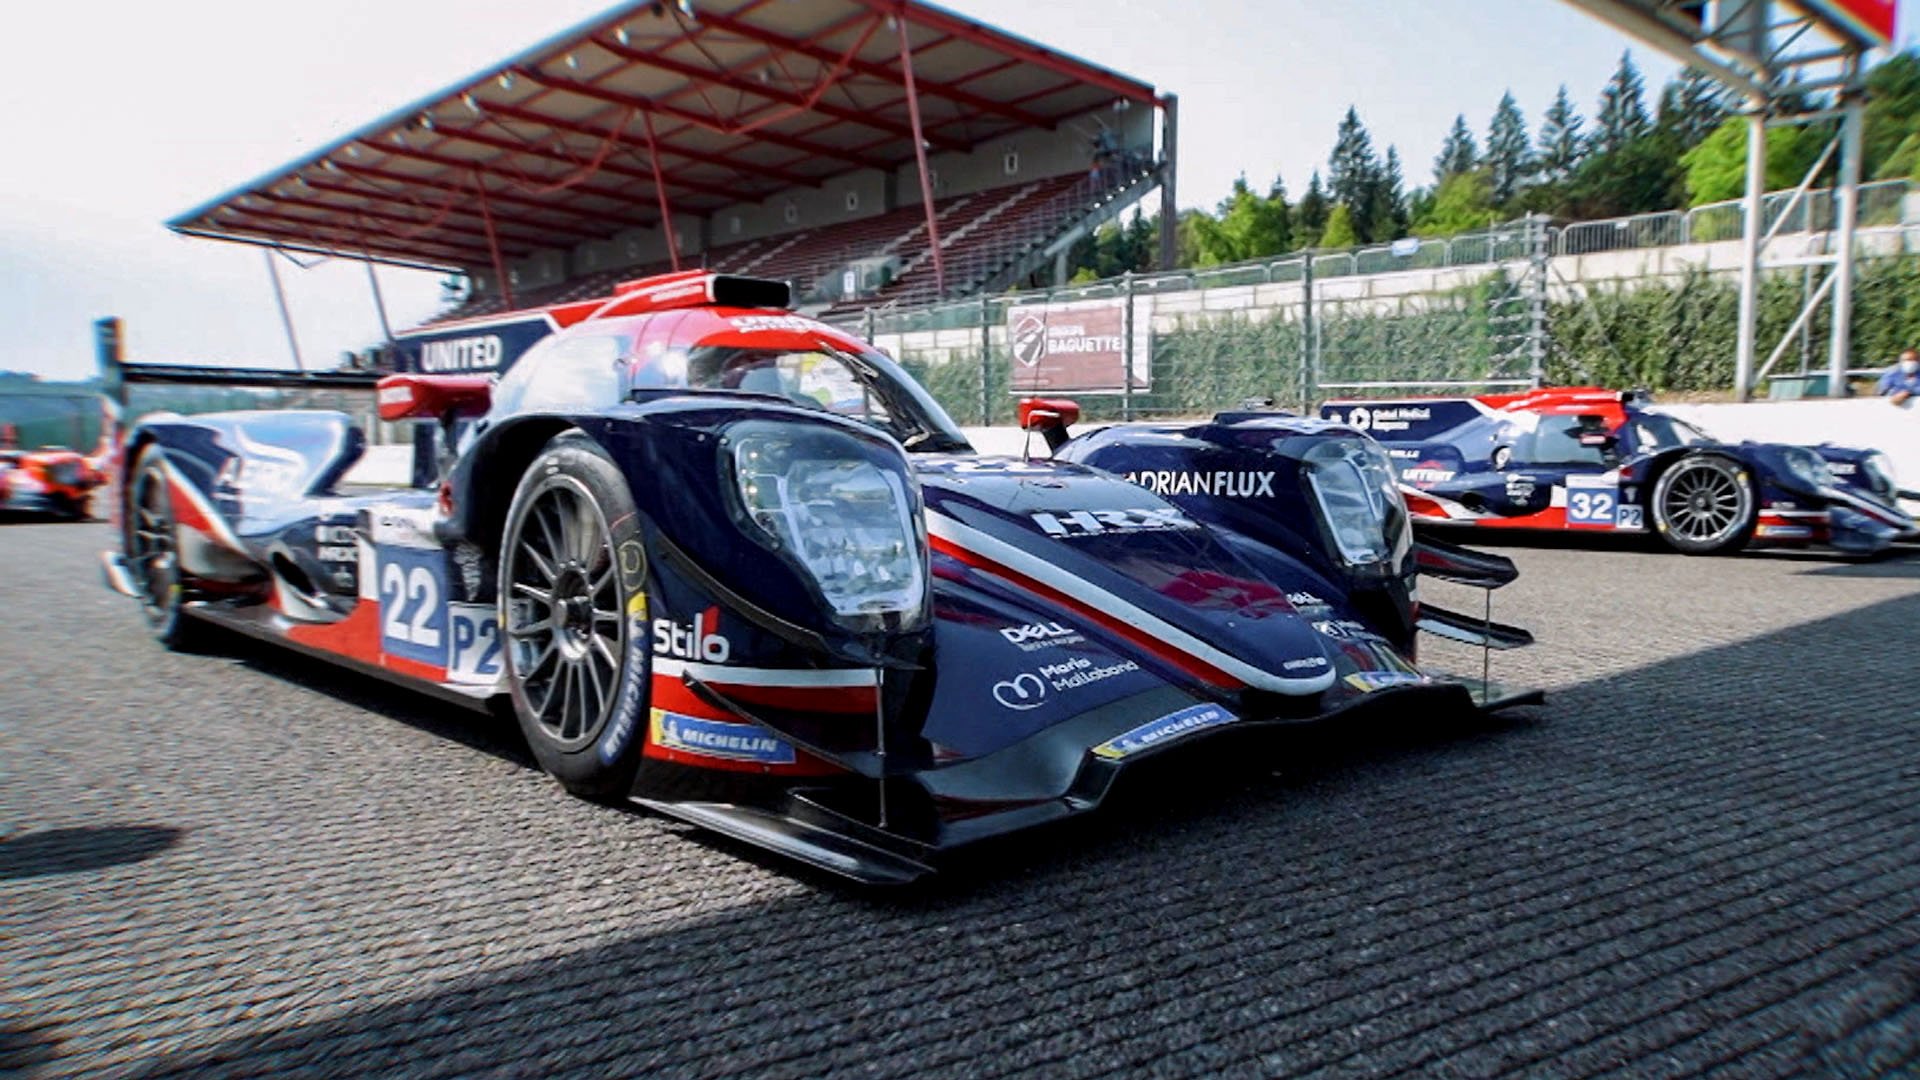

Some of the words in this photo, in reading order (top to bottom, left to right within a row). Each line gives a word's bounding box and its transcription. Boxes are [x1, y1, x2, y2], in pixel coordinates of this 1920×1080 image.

[421, 335, 502, 372] UNITED
[1046, 336, 1121, 354] BAGUETTE
[1570, 492, 1614, 520] 32
[1619, 508, 1642, 527] P2
[382, 563, 441, 648] 22
[453, 615, 500, 675] P2
[652, 612, 730, 664] Stilo
[1000, 622, 1075, 643] DELL
[1038, 657, 1092, 679] Maria
[682, 728, 778, 752] MICHELIN
[1141, 710, 1220, 743] MICHELIN
